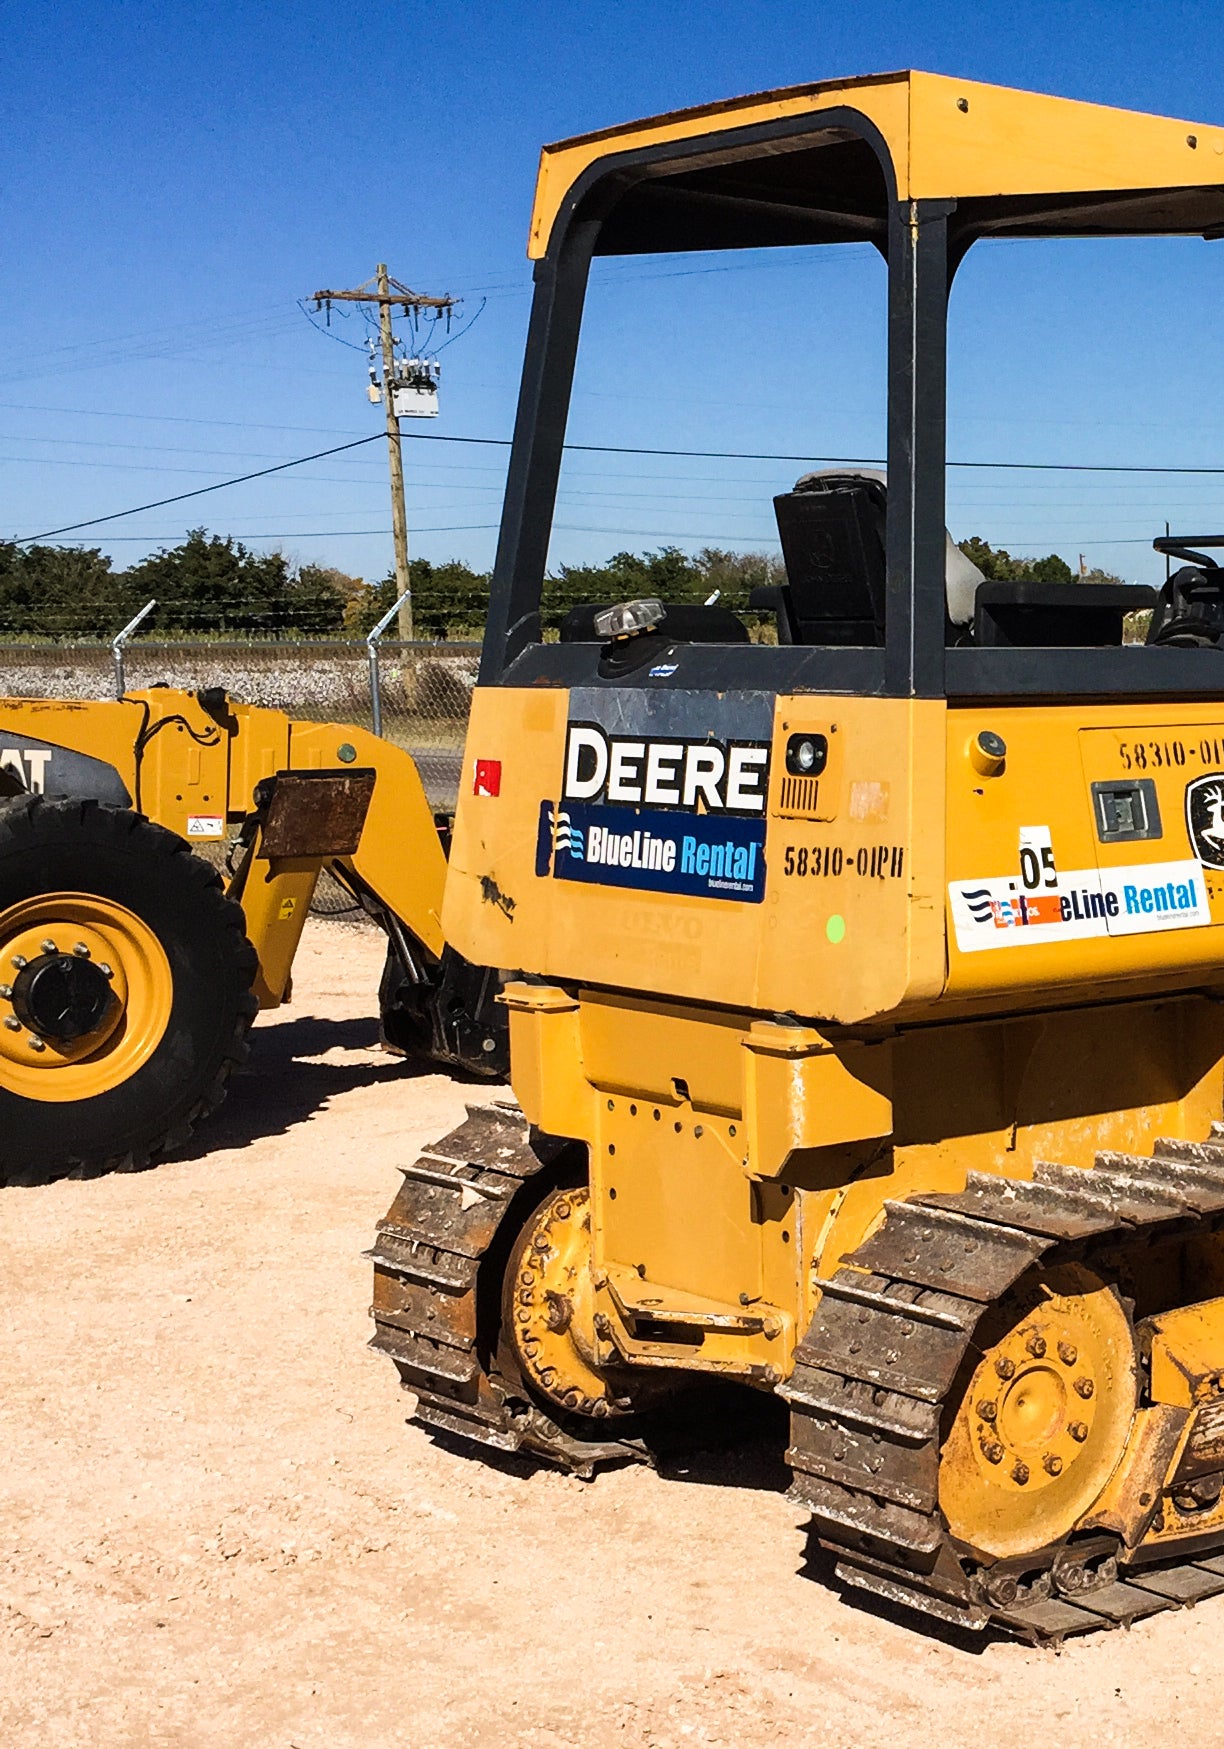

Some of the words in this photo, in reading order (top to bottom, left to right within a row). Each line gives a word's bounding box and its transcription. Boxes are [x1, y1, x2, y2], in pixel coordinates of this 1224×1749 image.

[564, 726, 769, 812] DEERE
[586, 825, 677, 873] BlueLine
[680, 835, 757, 881] Rental
[1123, 878, 1199, 915] Rental
